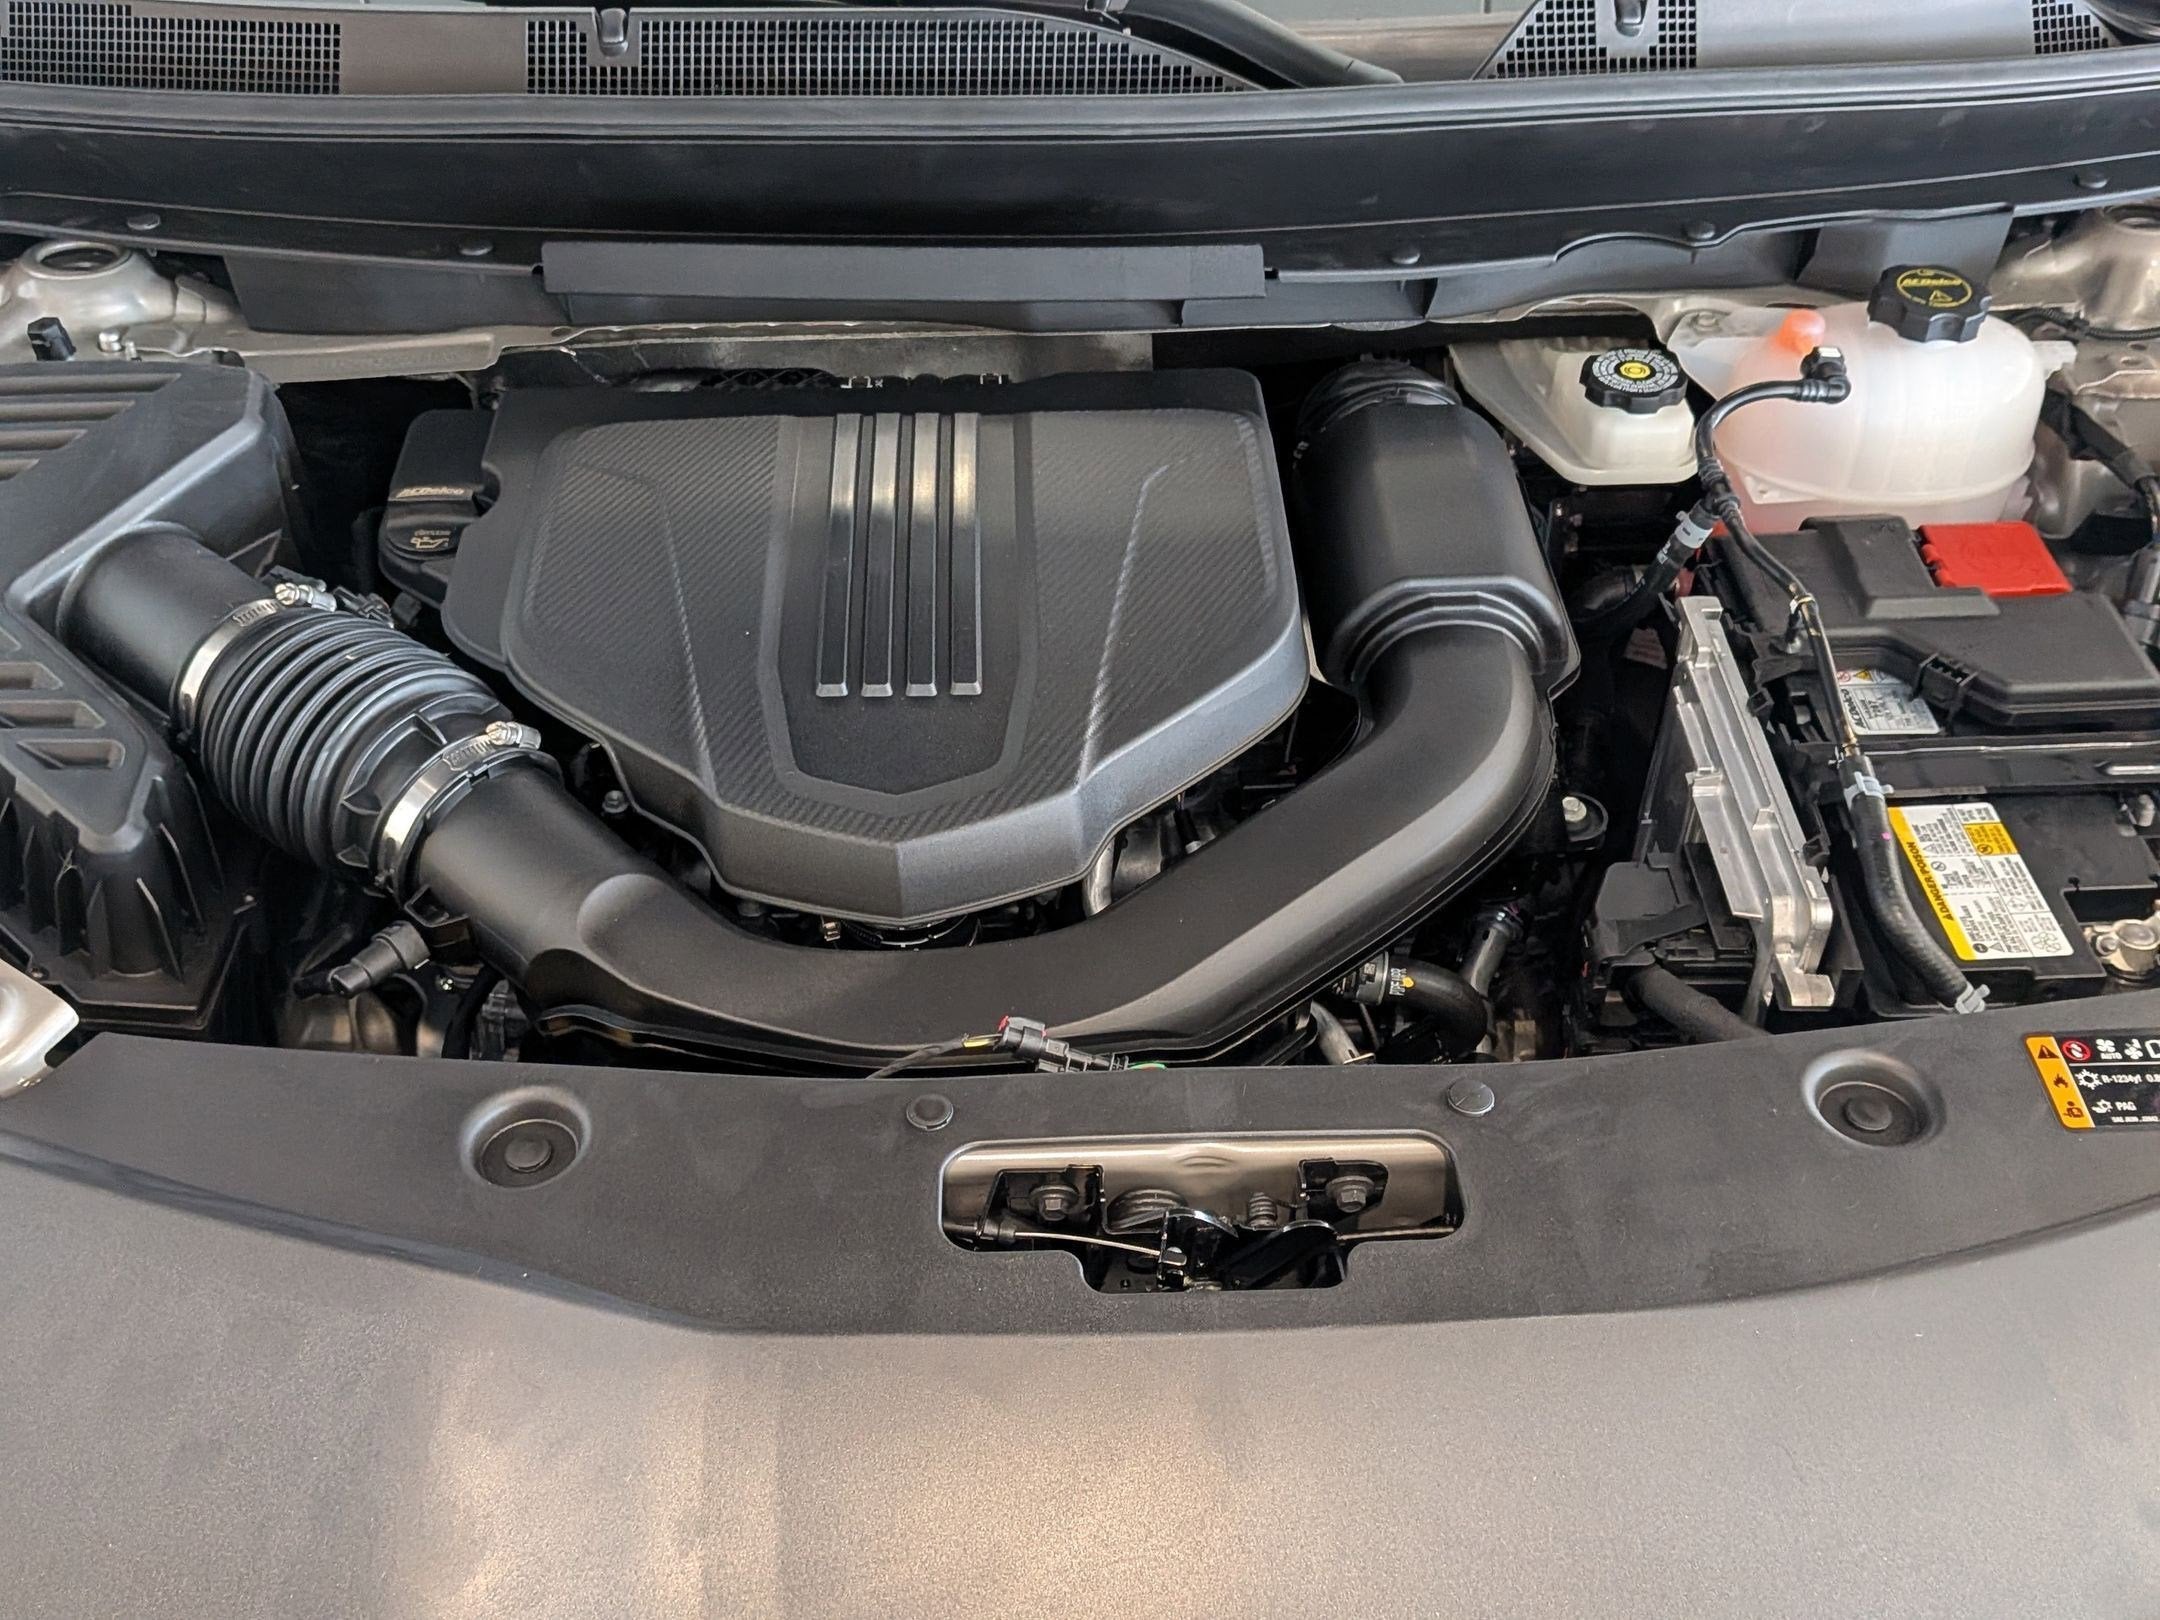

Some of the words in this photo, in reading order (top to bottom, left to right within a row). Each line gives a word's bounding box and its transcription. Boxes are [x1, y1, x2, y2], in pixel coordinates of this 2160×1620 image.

[1904, 841, 1930, 874] POISON
[1922, 875, 1950, 913] DANGER
[2100, 1052, 2123, 1060] AUTO
[2115, 1101, 2137, 1112] PAG
